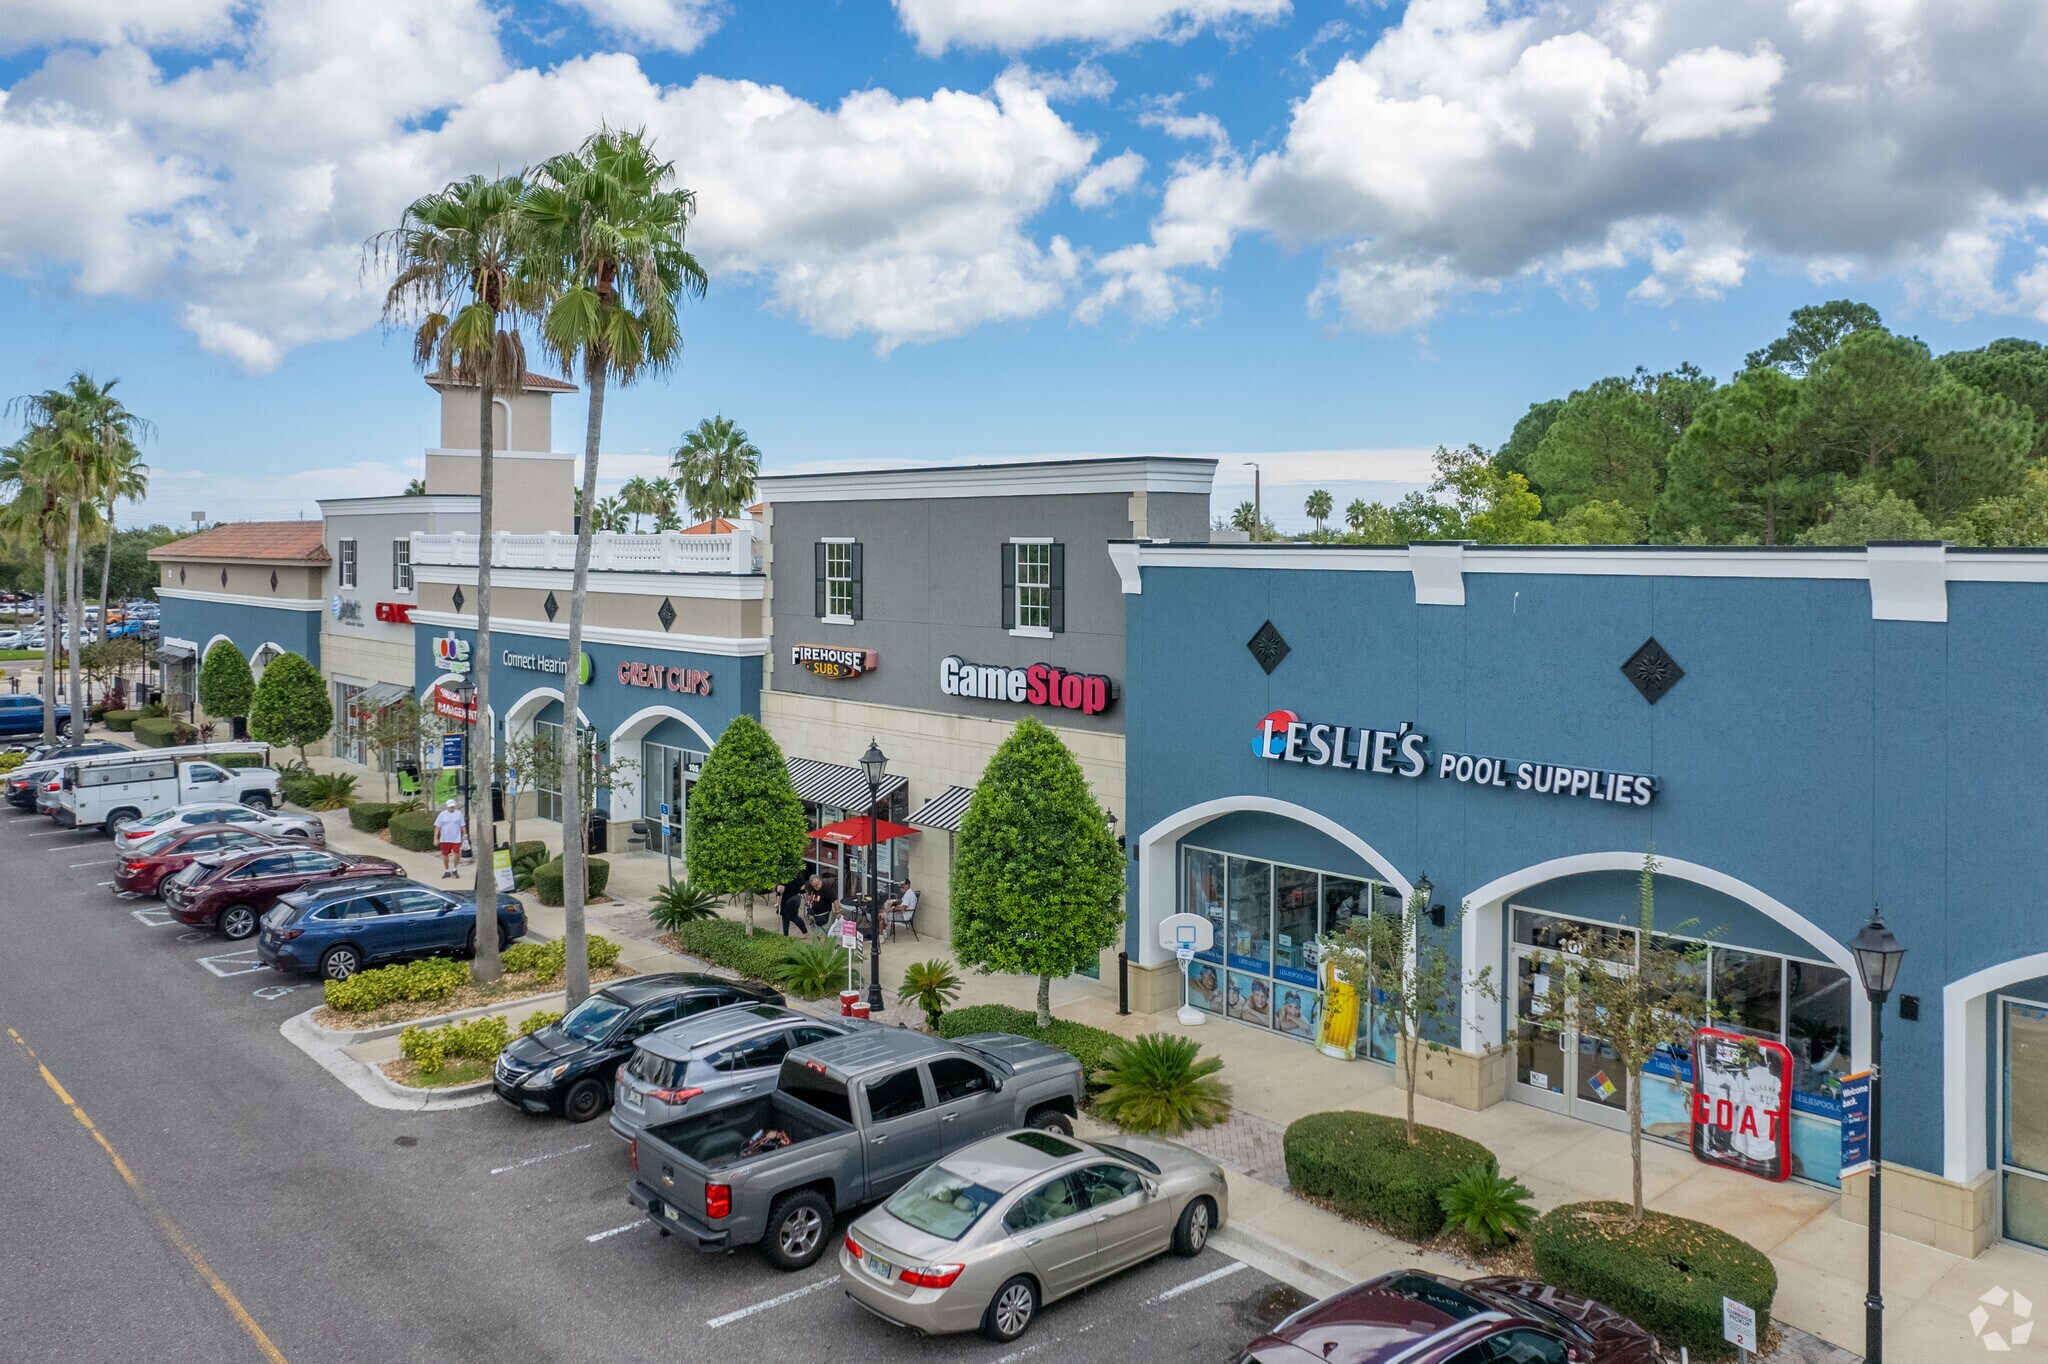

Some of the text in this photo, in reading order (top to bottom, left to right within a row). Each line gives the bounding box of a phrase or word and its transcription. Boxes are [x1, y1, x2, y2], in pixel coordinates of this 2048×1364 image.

[502, 650, 567, 674] Connect Hearin
[792, 646, 862, 672] FIREHOUSE
[813, 662, 839, 675] SUBS
[618, 661, 710, 696] GREAT CLIPS
[940, 657, 1106, 715] GameStop
[437, 702, 477, 720] MANAGEMNT
[688, 763, 699, 772] 105
[1261, 719, 1652, 806] LESLIE'S POOL SUPPLIES
[1842, 1085, 1869, 1098] Welcome
[1793, 1094, 1842, 1113] LESLIESPOOL.C
[1694, 1092, 1780, 1142] GOAT
[1727, 1307, 1753, 1323] CURBSIDE
[1729, 1313, 1751, 1327] PICKUP
[1737, 1334, 1744, 1345] 2
